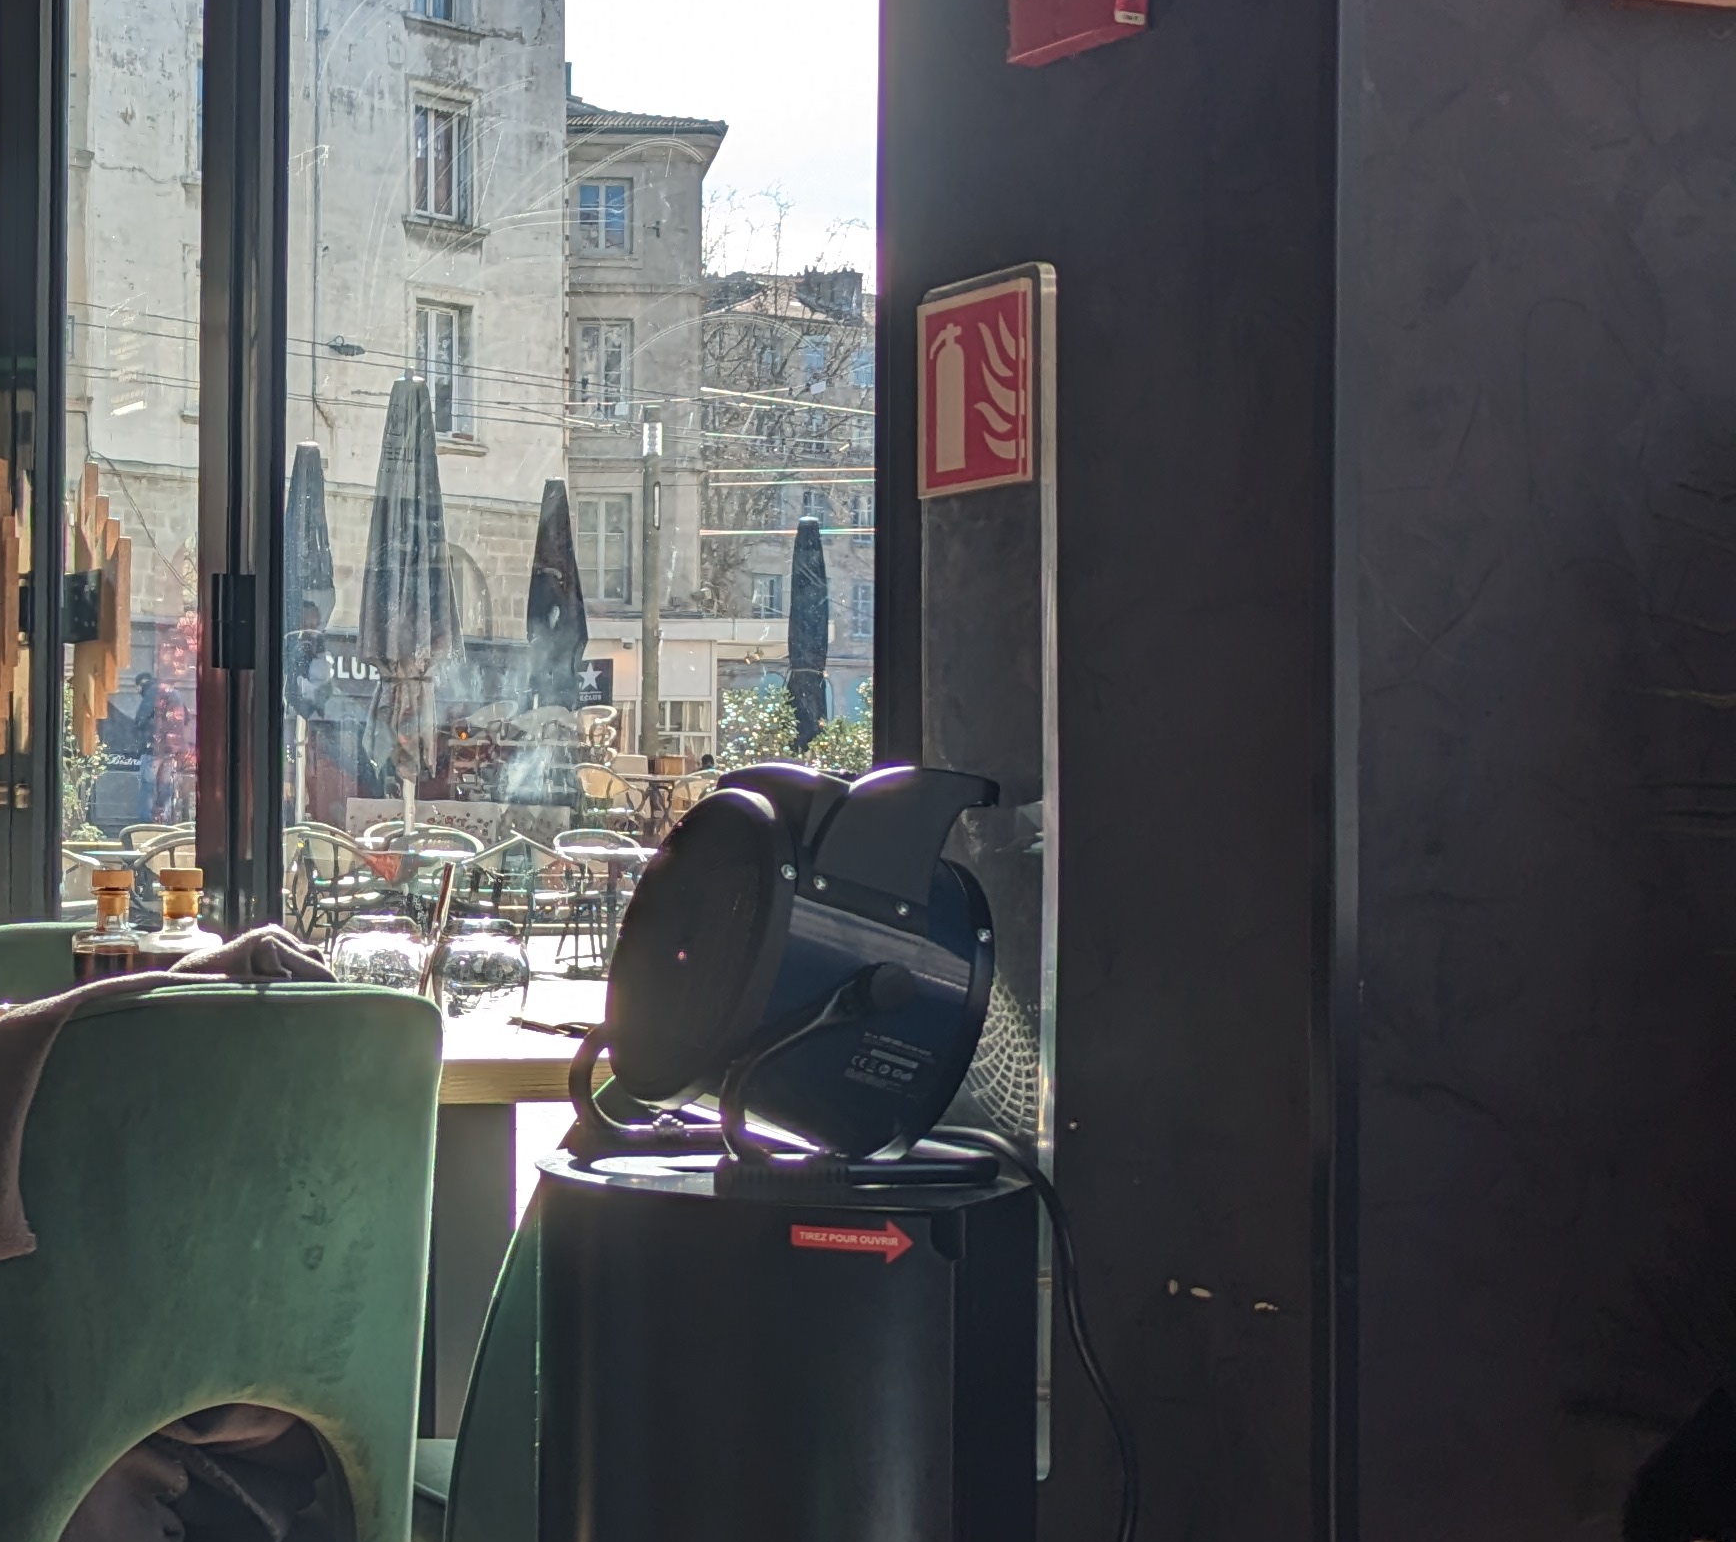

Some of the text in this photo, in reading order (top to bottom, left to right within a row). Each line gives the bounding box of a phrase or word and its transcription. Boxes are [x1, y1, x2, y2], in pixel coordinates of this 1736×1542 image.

[799, 1231, 899, 1247] TIREZ POUR OUVRIR
